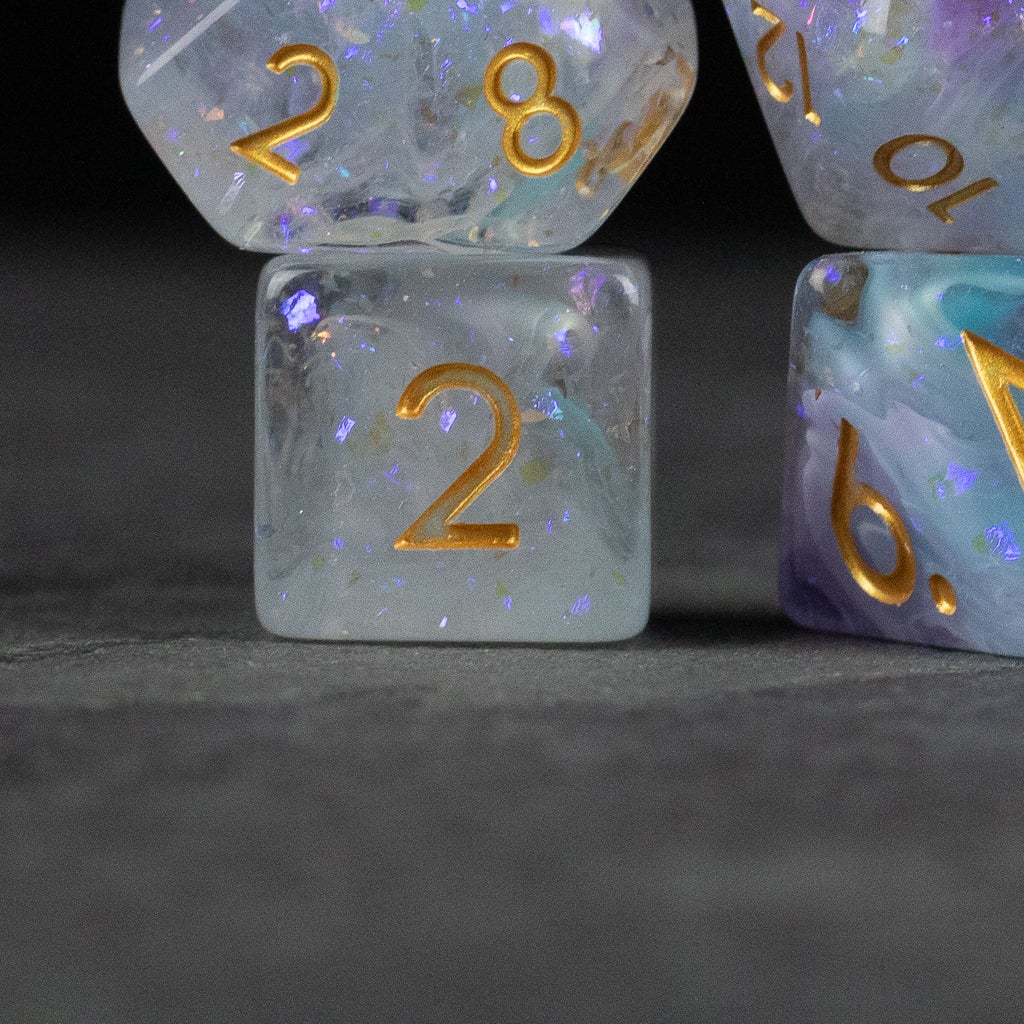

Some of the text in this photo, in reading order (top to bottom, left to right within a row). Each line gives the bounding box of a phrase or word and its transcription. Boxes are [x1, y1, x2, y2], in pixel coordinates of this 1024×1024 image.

[230, 43, 339, 186] 2
[484, 42, 583, 176] 8
[873, 133, 998, 224] 10
[393, 362, 522, 551] 2
